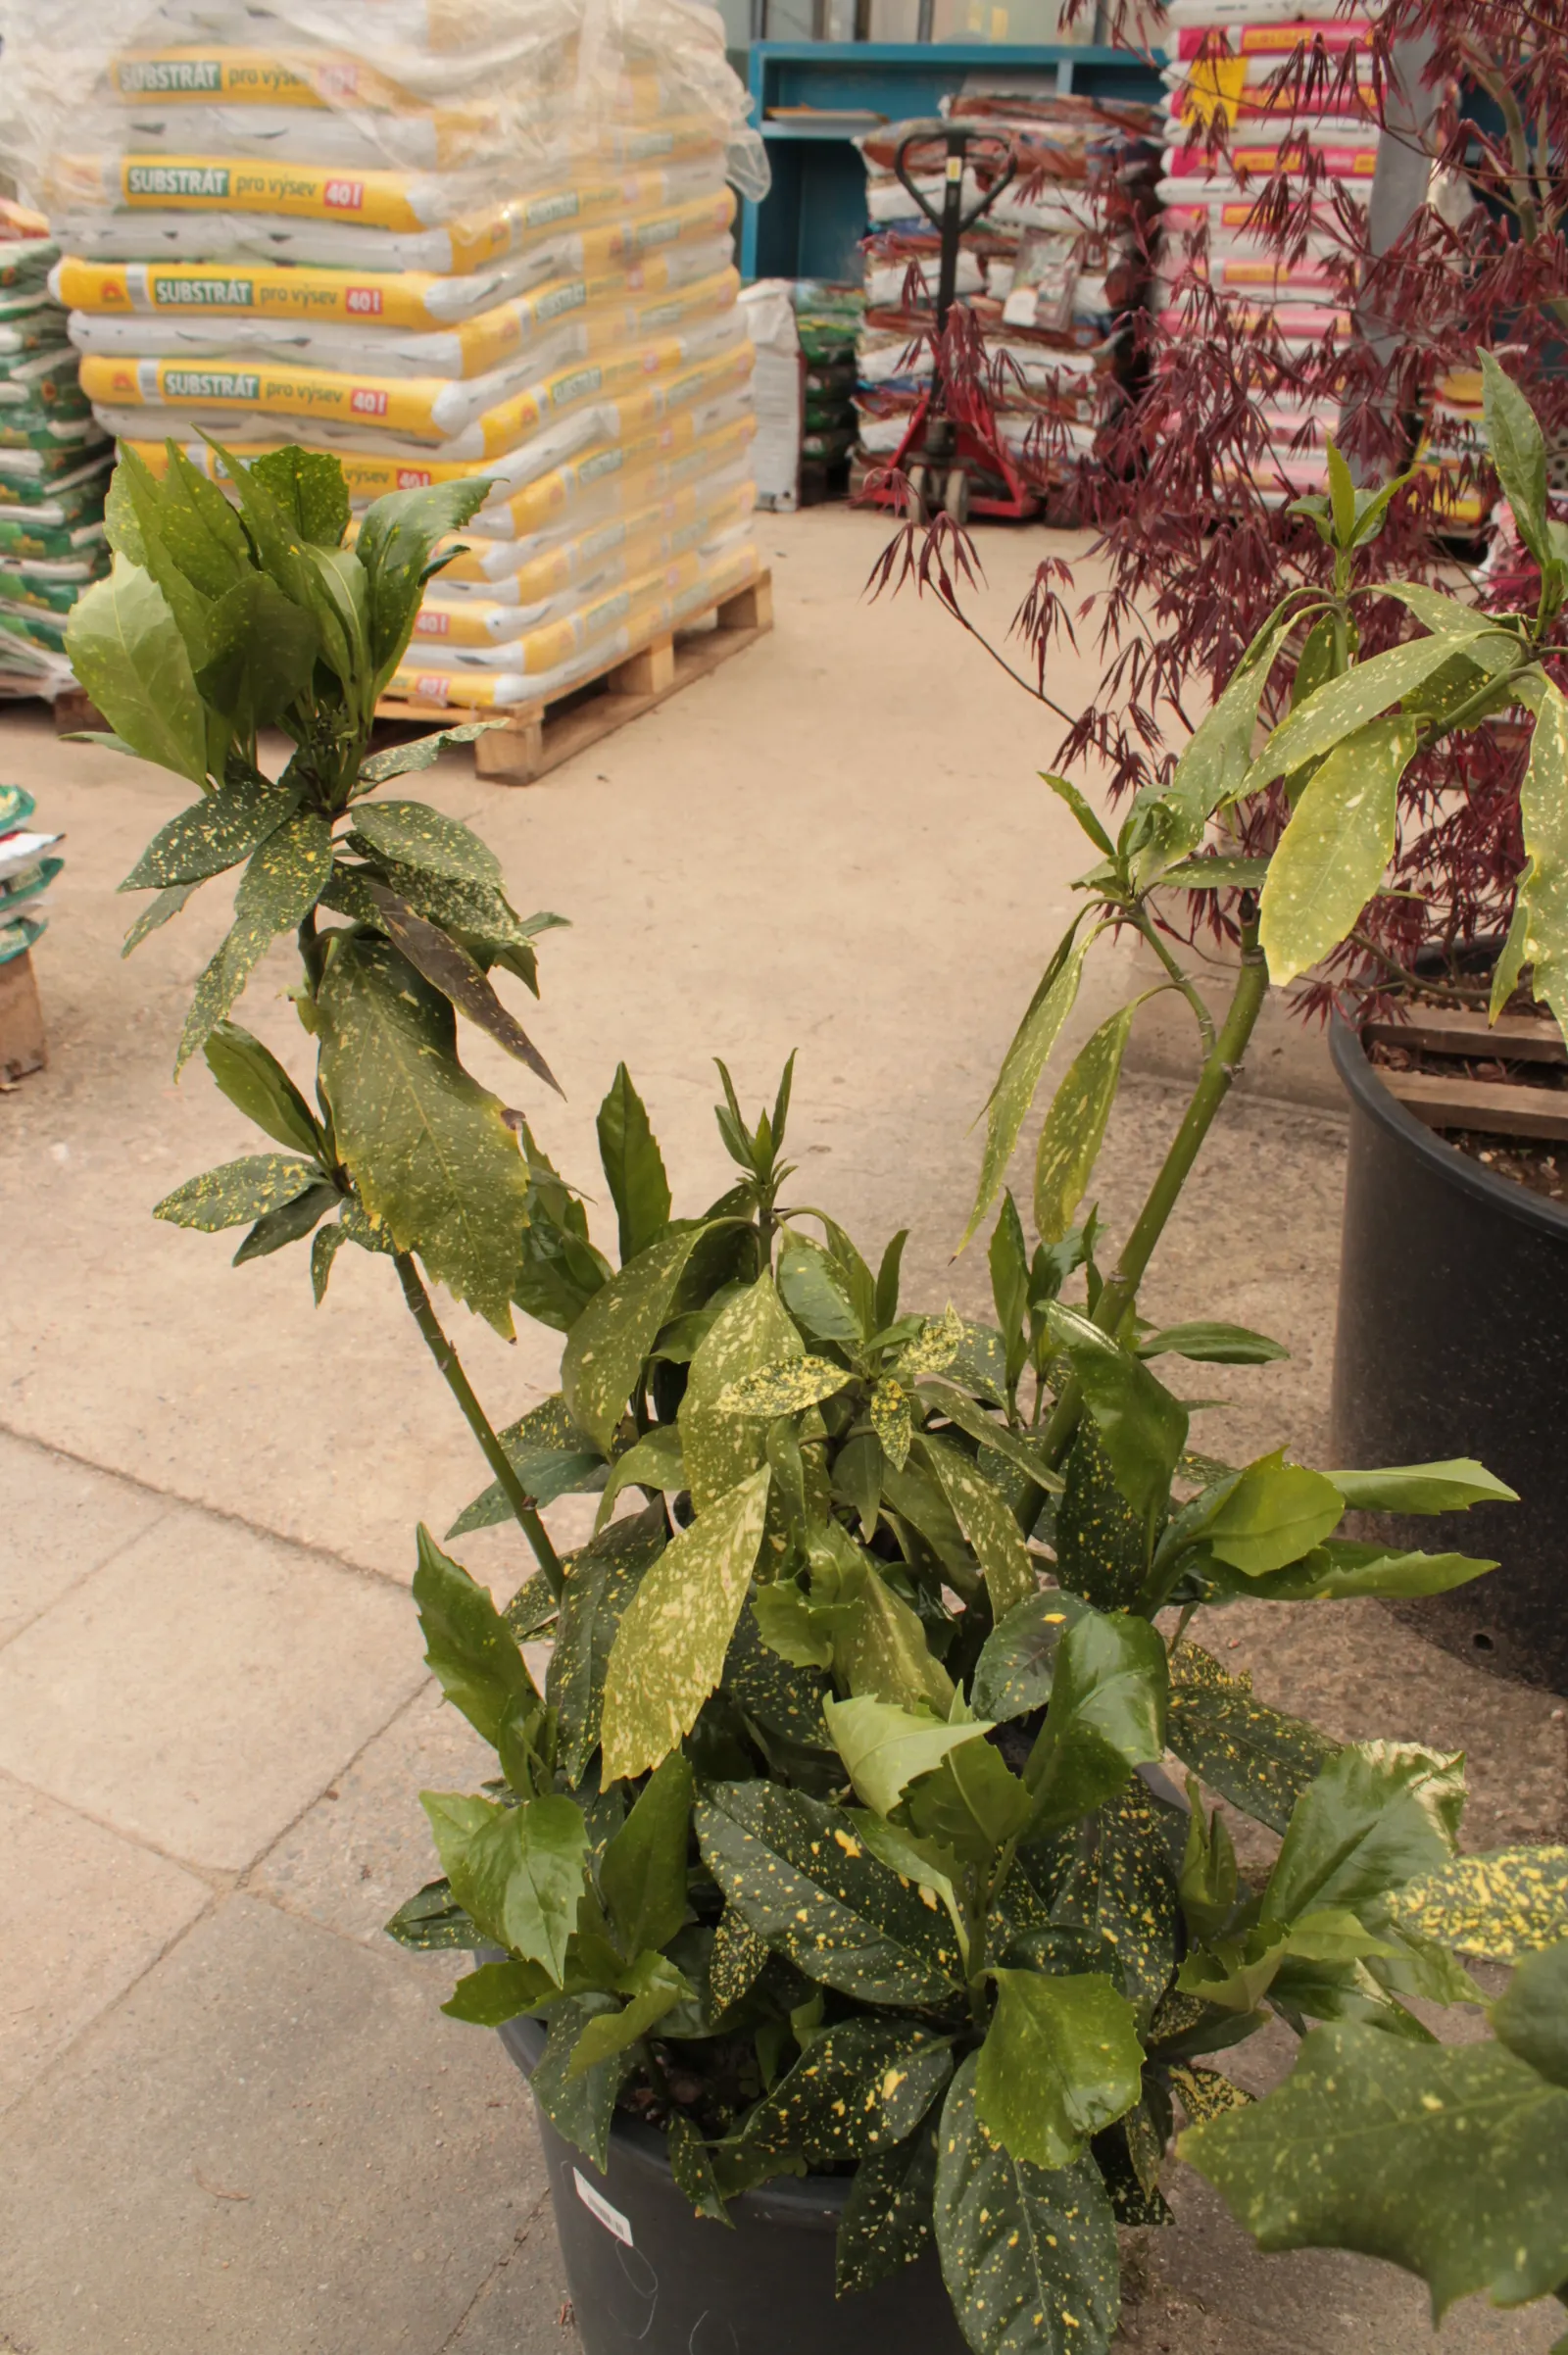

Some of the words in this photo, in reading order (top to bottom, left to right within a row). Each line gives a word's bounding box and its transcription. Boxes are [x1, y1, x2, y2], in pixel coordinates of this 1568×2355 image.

[228, 69, 259, 85] pro
[129, 167, 227, 194] SUBSTRÁT
[236, 176, 265, 193] pro
[269, 173, 317, 200] výsev
[156, 279, 251, 305] SUBSTRÁT
[260, 286, 288, 303] pro
[291, 284, 338, 308] výsev
[166, 373, 258, 398] SUBSTRÁT
[266, 382, 292, 399] pro
[297, 380, 343, 404] výsev
